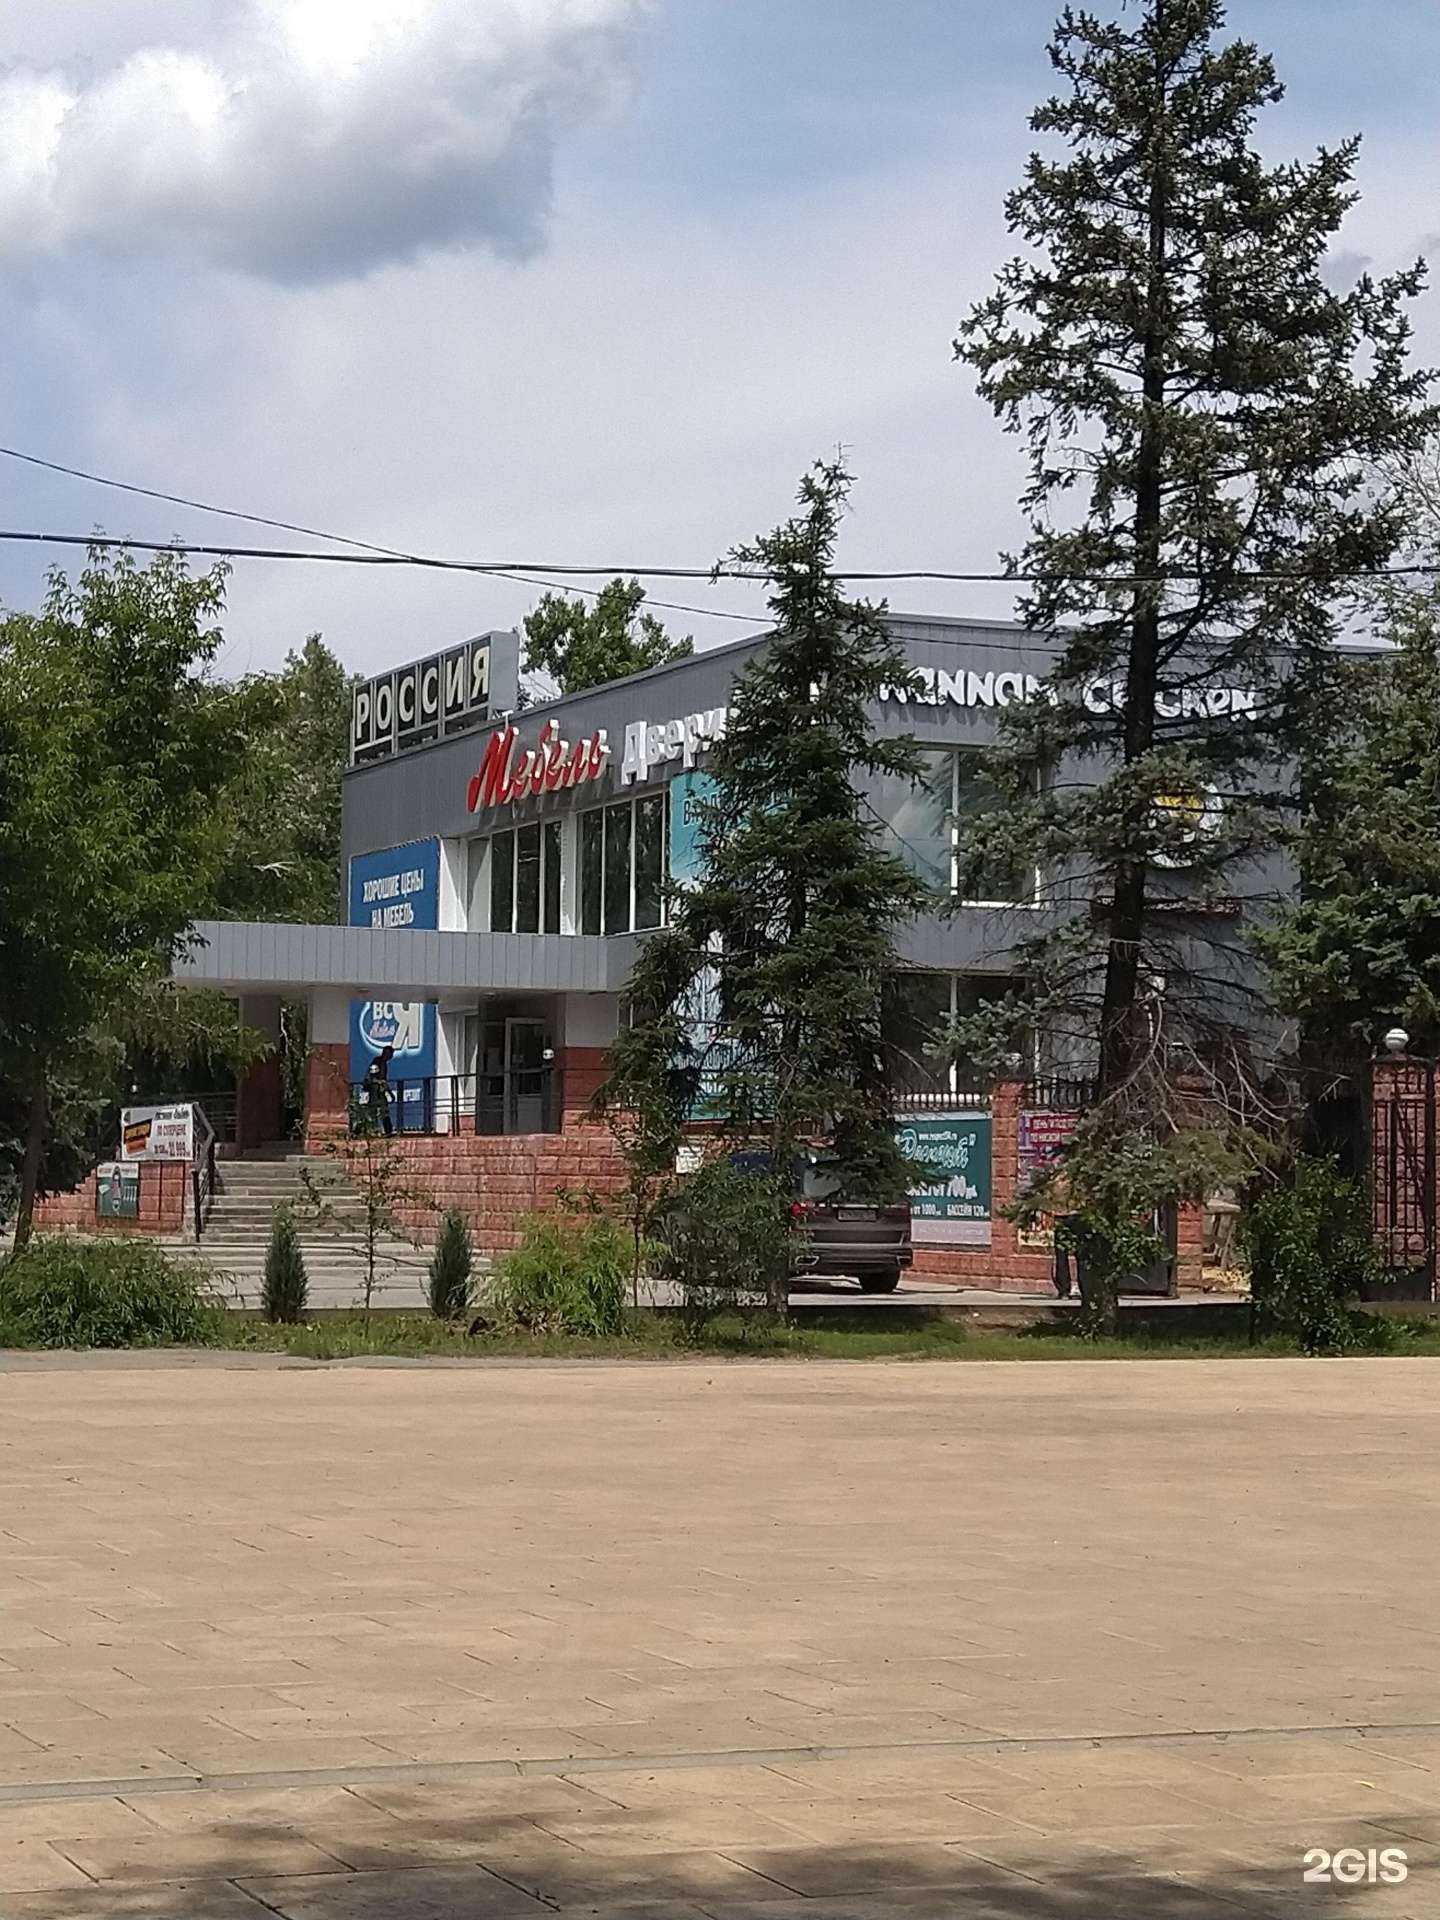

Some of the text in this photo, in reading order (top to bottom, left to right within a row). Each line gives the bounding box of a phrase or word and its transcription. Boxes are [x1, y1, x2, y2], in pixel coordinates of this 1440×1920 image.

[356, 646, 490, 739] РОССИЯ
[467, 719, 611, 814] Мебель
[363, 868, 424, 903] ХОРОШИЕ ЦЕНЫ
[371, 902, 414, 928] НА МЕБЕЛЬ
